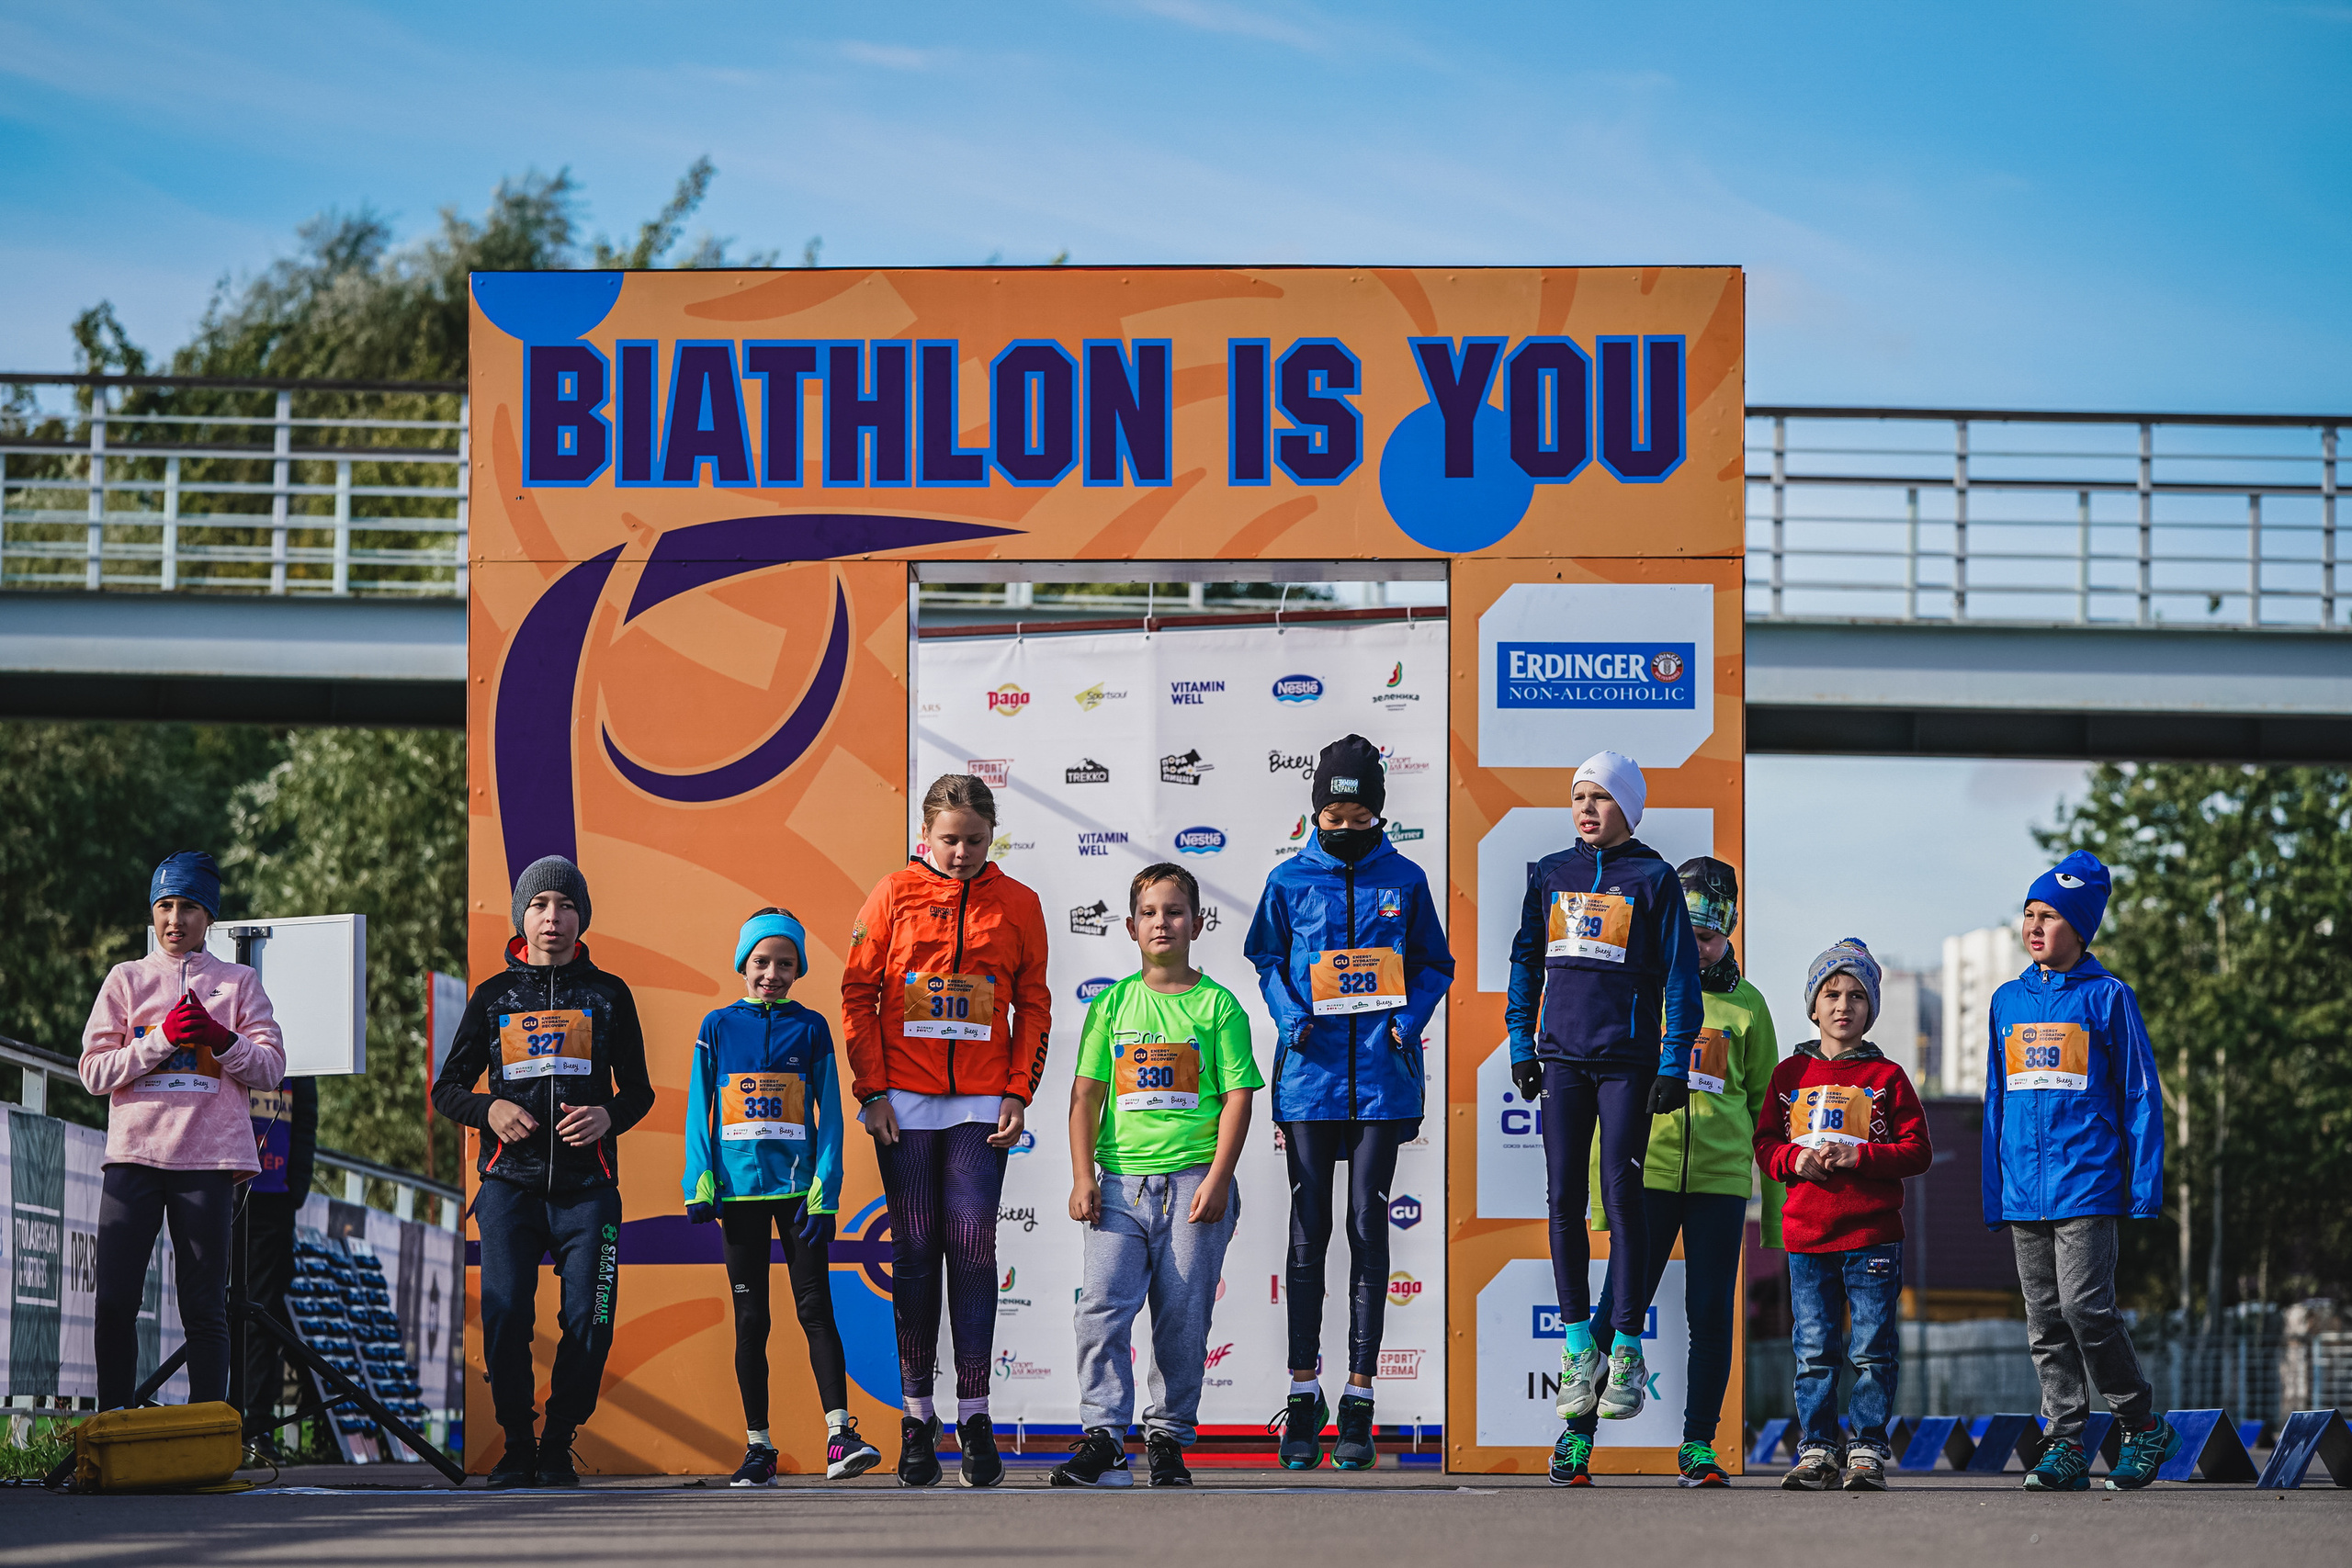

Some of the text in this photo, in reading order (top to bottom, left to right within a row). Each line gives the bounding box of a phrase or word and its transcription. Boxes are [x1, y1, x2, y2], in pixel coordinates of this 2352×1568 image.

[523, 334, 1687, 488] BIATHLON IS YOU
[1509, 650, 1649, 682] ERDINGER
[1170, 681, 1226, 693] VITAMIN
[1509, 686, 1685, 701] NON-ALCOHOLIC
[1170, 694, 1204, 705] WELL
[971, 762, 1002, 773] SPORT
[1269, 753, 1316, 780] Bitey
[983, 773, 1004, 784] RMA
[1068, 772, 1108, 783] TREKKO
[1078, 832, 1129, 844] VITAMIN
[1078, 845, 1109, 856] WELL
[1338, 971, 1377, 994] 328
[931, 995, 969, 1020] 310
[527, 1032, 566, 1056] 327
[2025, 1045, 2061, 1068] 339
[1136, 1066, 1174, 1089] 330
[744, 1096, 783, 1119] 336
[1390, 1205, 1419, 1220] GU
[71, 1231, 96, 1293] ПРАВ
[593, 1244, 616, 1325] STAY TRUE
[1386, 1280, 1422, 1298] ago
[1380, 1353, 1415, 1364] SPORT
[1380, 1365, 1415, 1376] FERMA
